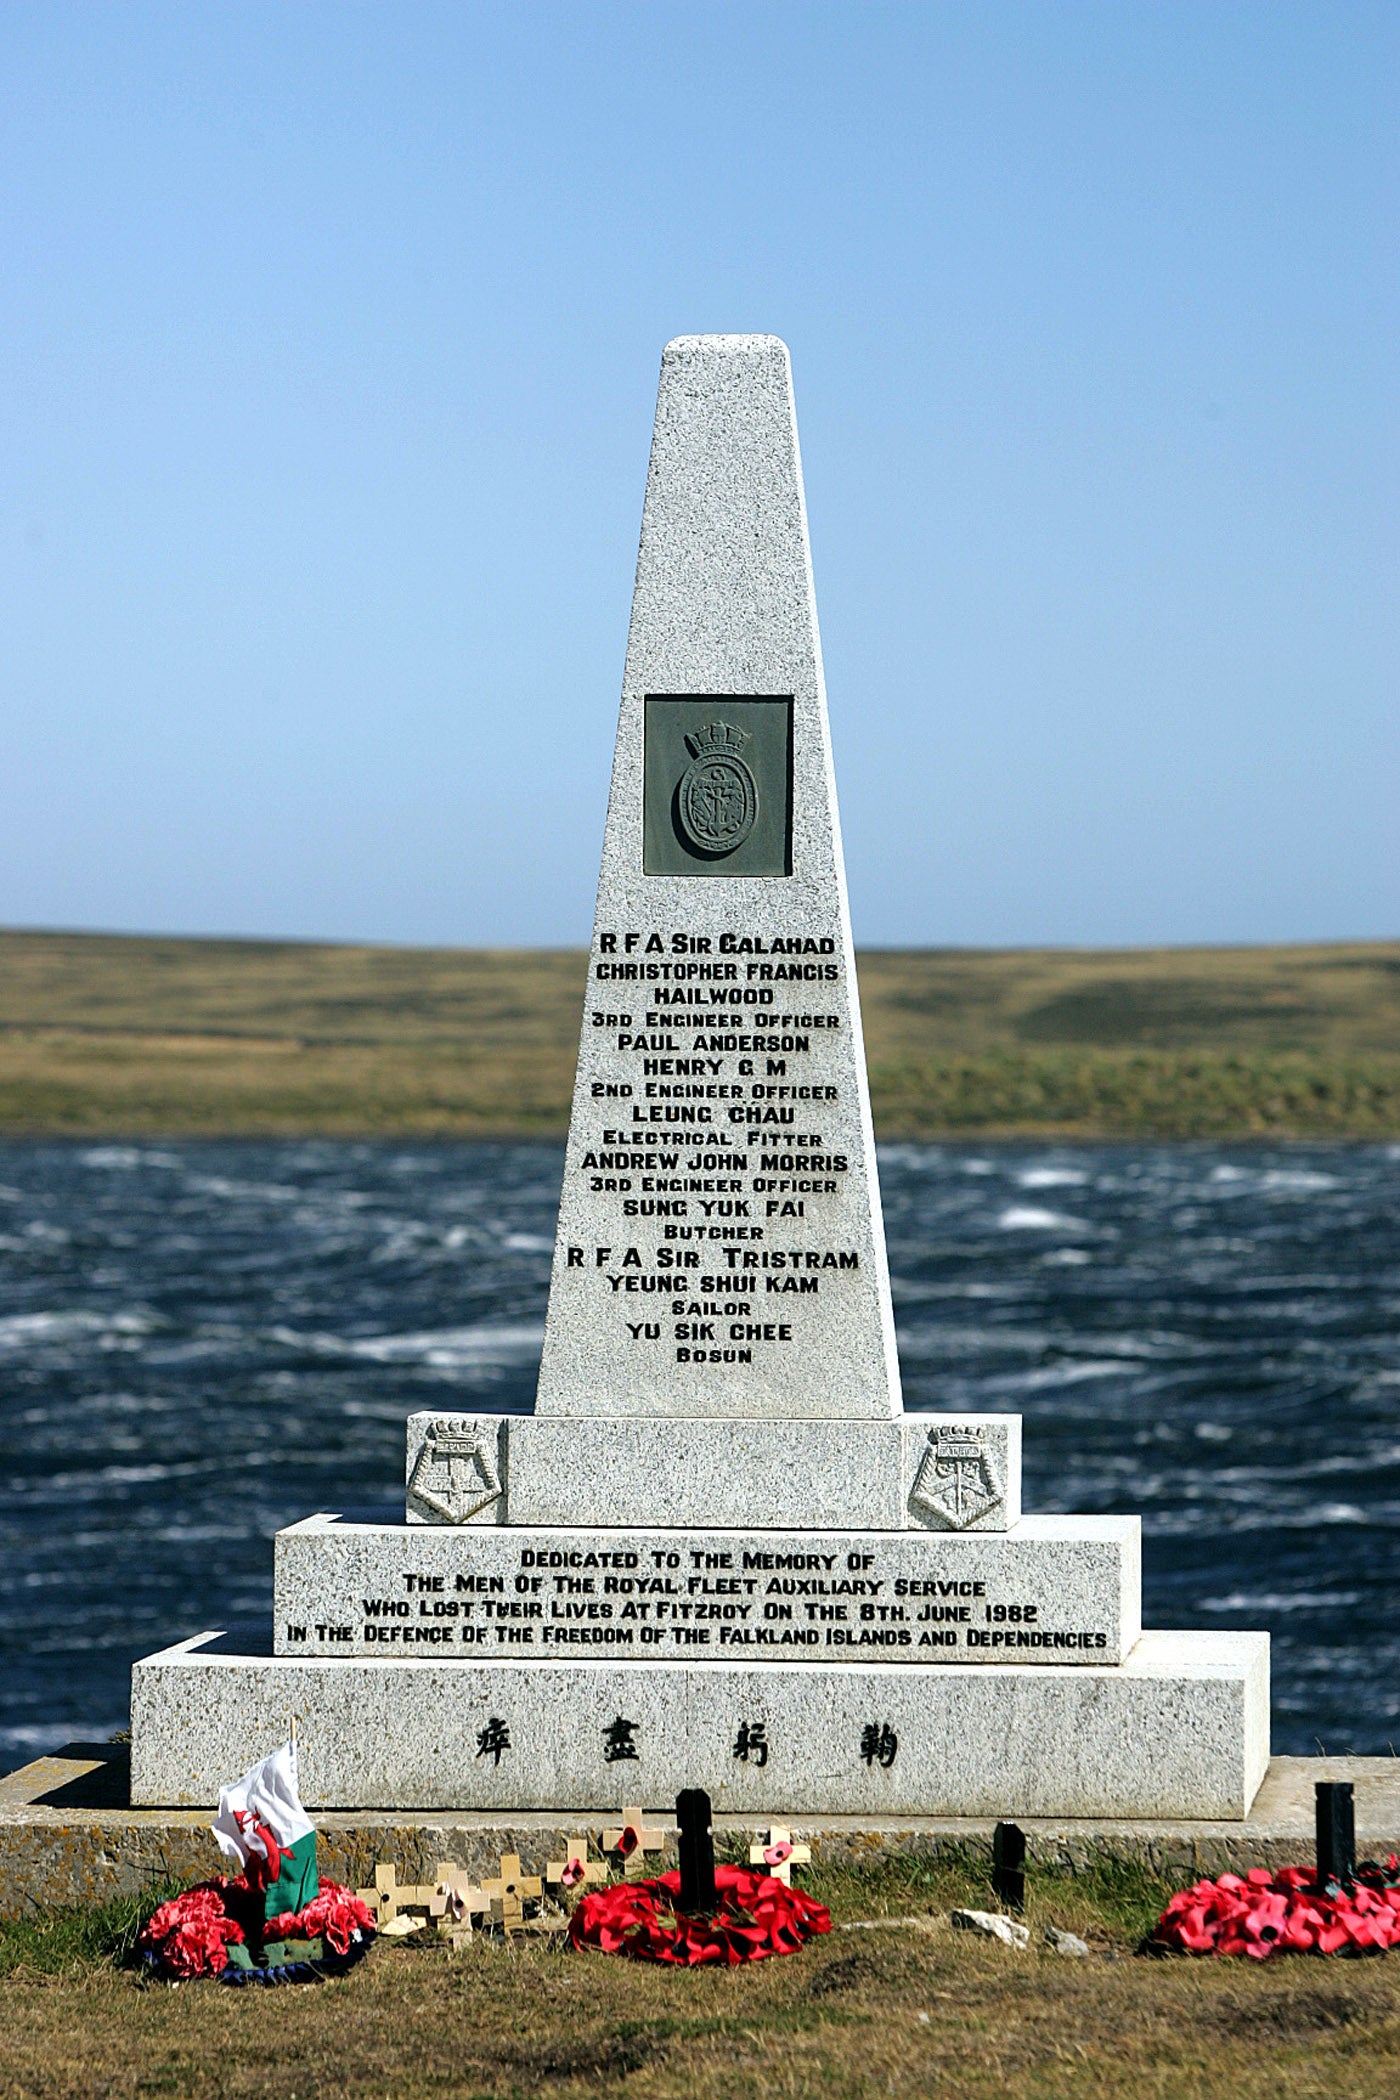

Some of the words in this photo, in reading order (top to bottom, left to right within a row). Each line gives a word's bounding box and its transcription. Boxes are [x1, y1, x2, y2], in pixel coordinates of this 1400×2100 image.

[600, 934, 616, 953] R
[625, 934, 640, 953] F
[649, 934, 664, 954] A
[672, 934, 711, 954] SIR
[719, 933, 834, 954] GALAHAD
[597, 964, 737, 980] CHRISTOPHER
[747, 964, 838, 980] FRANCIS
[655, 988, 773, 1004] HAILWOOD
[592, 1012, 632, 1027] 3RD
[646, 1012, 742, 1027] ENGINEER
[755, 1013, 839, 1028] OFFICER
[618, 1035, 679, 1050] PAUL
[693, 1035, 809, 1051] ANDERSON
[644, 1060, 724, 1075] HENRY
[739, 1060, 753, 1075] G
[767, 1060, 786, 1075] M
[591, 1083, 632, 1097] 2ND
[646, 1083, 742, 1098] ENGINEER
[752, 1084, 837, 1099] OFFICER
[633, 1106, 712, 1122] LEUNG
[729, 1107, 794, 1123] CHAU
[604, 1130, 732, 1145] ELECTRICAL
[748, 1132, 822, 1146] FITTER
[582, 1153, 679, 1169] ANDREW
[688, 1154, 747, 1170] JOHN
[761, 1155, 847, 1171] MORRIS
[591, 1178, 631, 1191] 3RD
[642, 1178, 742, 1192] ENGINEER
[753, 1179, 836, 1193] OFFICER
[624, 1200, 687, 1216] SUNG
[701, 1201, 751, 1216] YUK
[766, 1201, 803, 1216] FAI
[665, 1225, 763, 1239] BUTCHER
[568, 1249, 584, 1267] R
[596, 1249, 612, 1267] F
[623, 1249, 642, 1267] A
[657, 1249, 699, 1268] SIR
[723, 1248, 858, 1269] TRISTRAM
[607, 1276, 687, 1292] YEUNG
[701, 1276, 756, 1292] SHUI
[766, 1277, 818, 1292] KAM
[672, 1301, 750, 1315] SAILOR
[626, 1323, 660, 1339] YU
[675, 1324, 715, 1340] SIK
[730, 1324, 791, 1340] CHEE
[677, 1348, 751, 1362] BOSUN
[521, 1550, 638, 1568] DEDICATED
[651, 1551, 680, 1568] TO
[691, 1552, 732, 1568] THE
[743, 1552, 837, 1570] MEMORY
[848, 1554, 875, 1570] OF
[403, 1574, 443, 1592] THE
[456, 1575, 503, 1592] MEN
[515, 1575, 542, 1593] OF
[553, 1576, 593, 1593] THE
[604, 1576, 677, 1594] ROYAL
[689, 1576, 757, 1594] FLEET
[766, 1578, 884, 1595] AUXILIARY
[895, 1579, 985, 1596] SERVICE
[362, 1600, 409, 1616] WHO
[420, 1601, 474, 1617] LOST
[485, 1601, 542, 1618] THEIR
[551, 1602, 613, 1618] LIVES
[621, 1603, 650, 1619] AT
[657, 1603, 752, 1620] FITZROY
[764, 1603, 792, 1620] ON
[805, 1604, 847, 1620] THE
[918, 1605, 970, 1621] JUNE
[986, 1606, 1037, 1622] 1982
[288, 1625, 306, 1641] IN
[315, 1625, 353, 1641] THE
[364, 1625, 452, 1642] DEFENCE
[462, 1626, 487, 1643] OF
[498, 1626, 533, 1643] THE
[542, 1627, 633, 1643] FREEDOM
[641, 1627, 664, 1643] OF
[671, 1627, 710, 1644] THE
[720, 1628, 819, 1645] FALKLAND
[826, 1629, 911, 1645] ISLANDS
[919, 1629, 957, 1646] AND
[967, 1630, 1106, 1648] DEPENDENCIES
